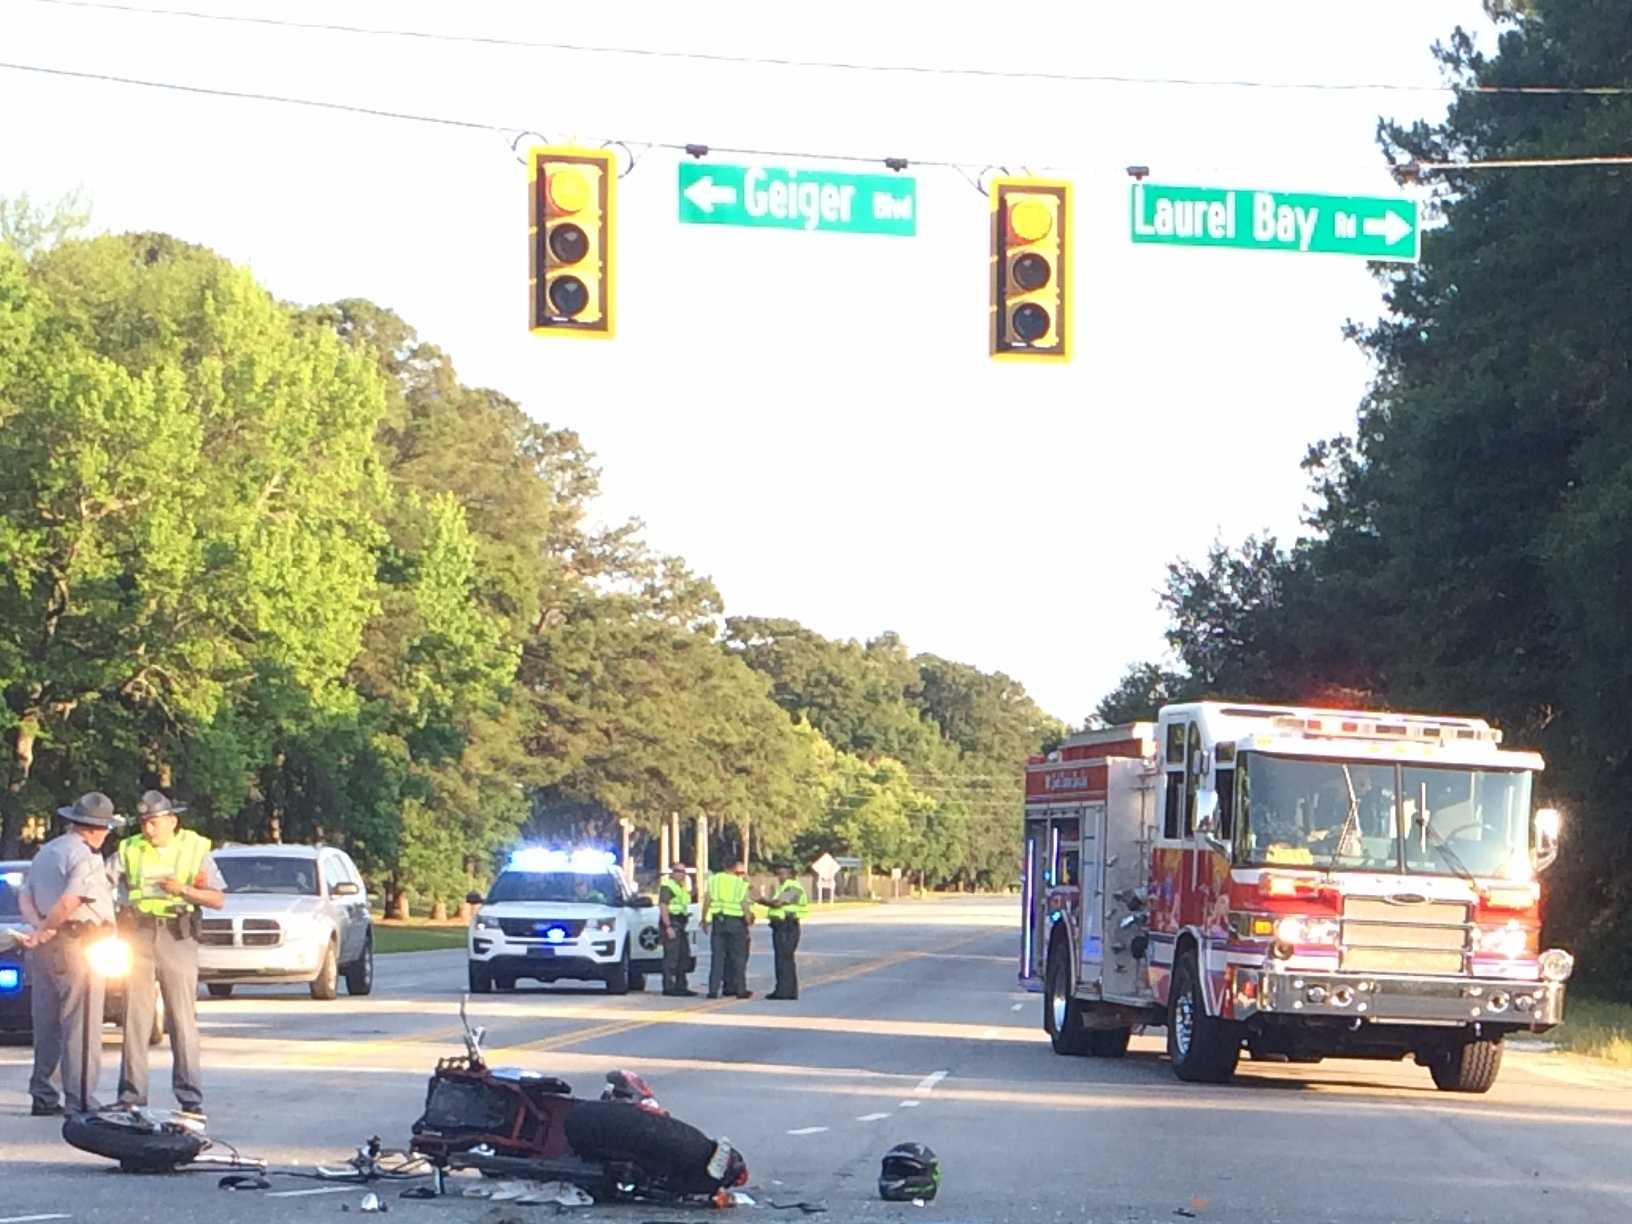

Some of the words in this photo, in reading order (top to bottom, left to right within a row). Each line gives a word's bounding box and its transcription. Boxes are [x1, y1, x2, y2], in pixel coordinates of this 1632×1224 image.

[743, 166, 855, 230] Geiger
[1134, 184, 1236, 239] Laurel
[1252, 192, 1319, 252] Bay
[1334, 210, 1357, 239] Rd
